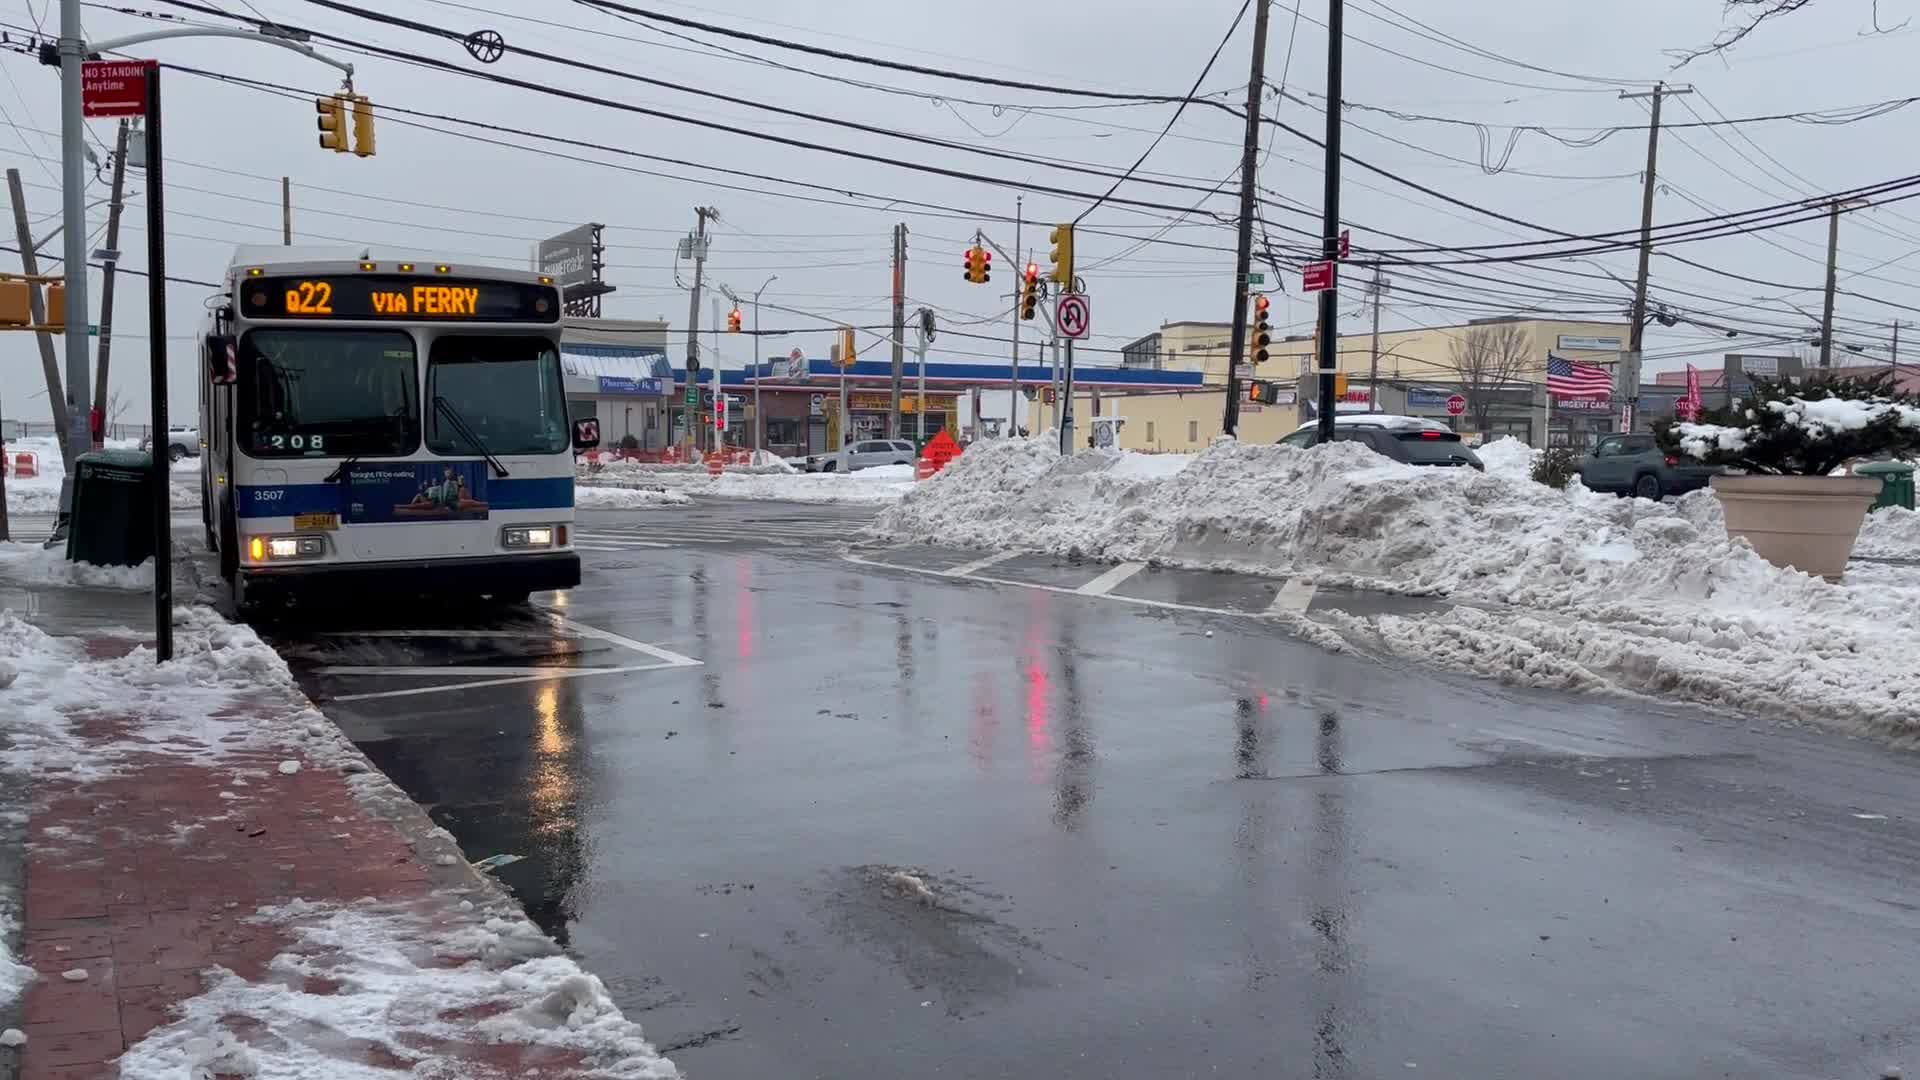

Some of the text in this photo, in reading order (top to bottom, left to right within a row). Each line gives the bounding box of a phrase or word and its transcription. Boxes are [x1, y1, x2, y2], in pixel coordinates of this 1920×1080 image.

[85, 67, 98, 78] NO
[86, 80, 125, 93] Anytime
[286, 281, 479, 314] Q22 VIA FERRY
[1447, 400, 1465, 409] STOP
[1558, 400, 1588, 409] URGENT
[1676, 402, 1689, 410] STO
[254, 490, 284, 501] 3507
